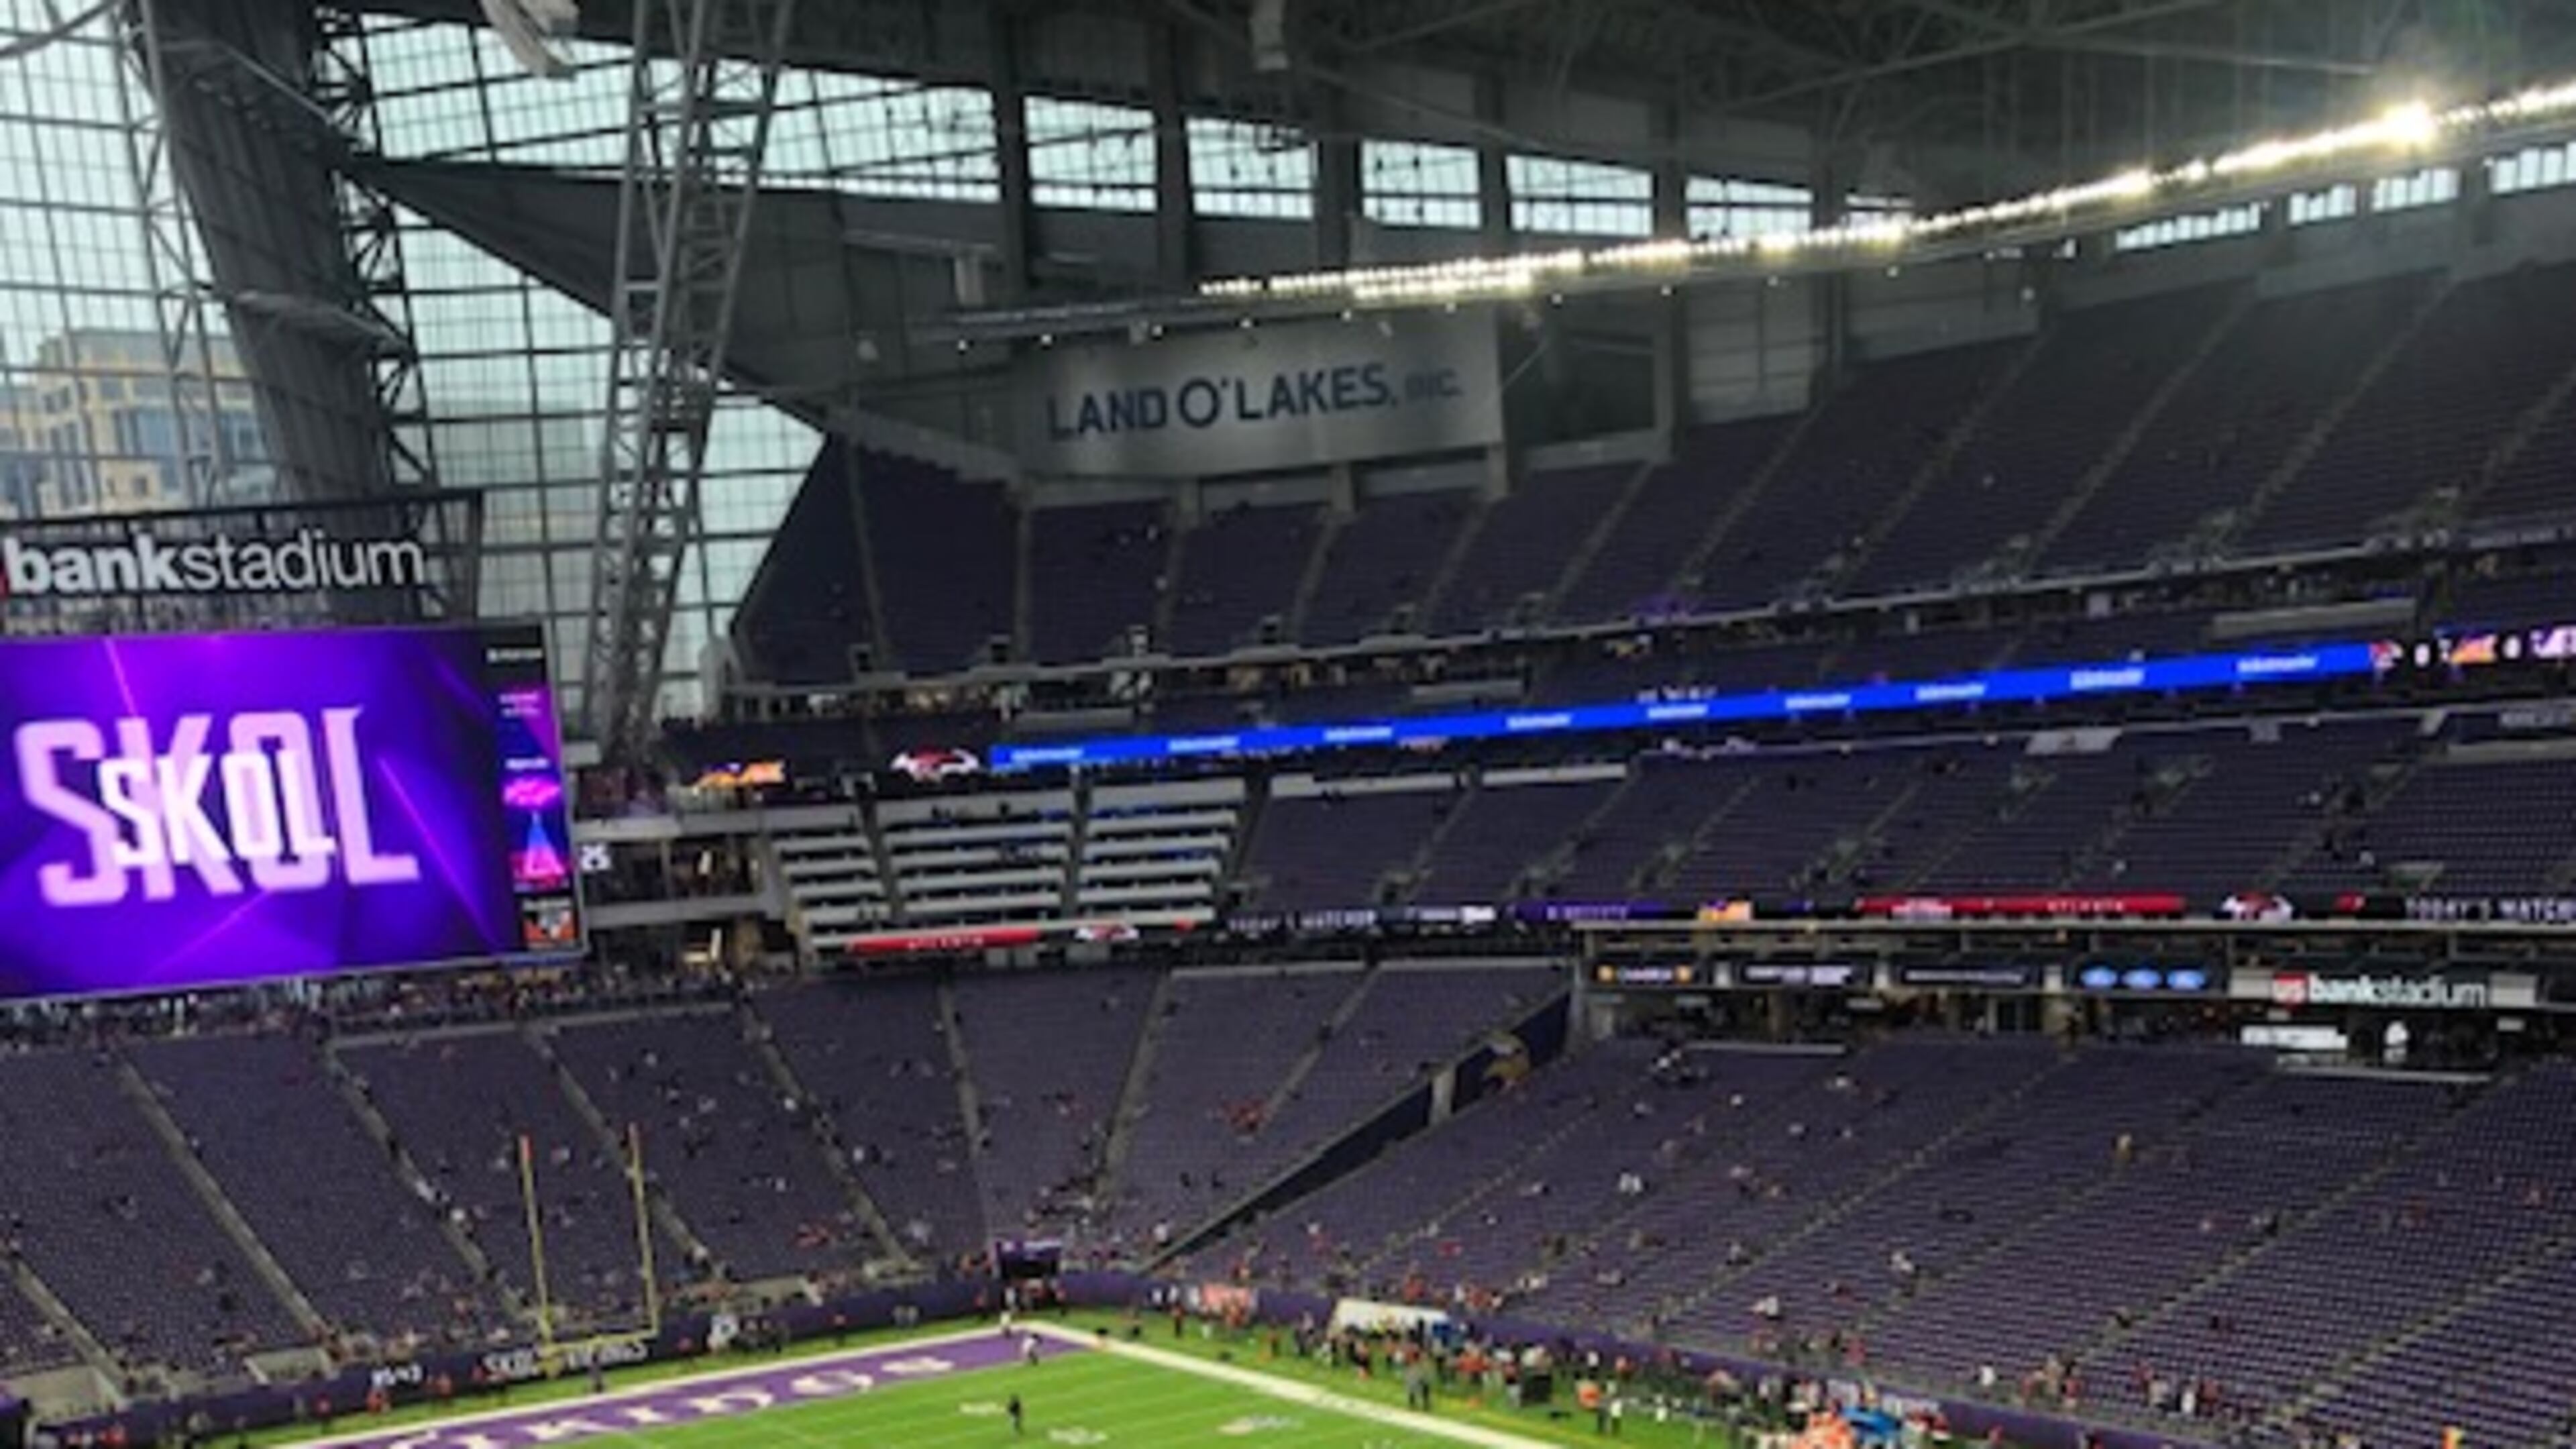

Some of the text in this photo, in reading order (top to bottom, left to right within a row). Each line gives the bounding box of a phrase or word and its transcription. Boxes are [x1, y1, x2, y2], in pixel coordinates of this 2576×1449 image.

[1047, 387, 1168, 440] LAND
[15, 704, 421, 908] SKOL
[98, 747, 337, 868] SKOL
